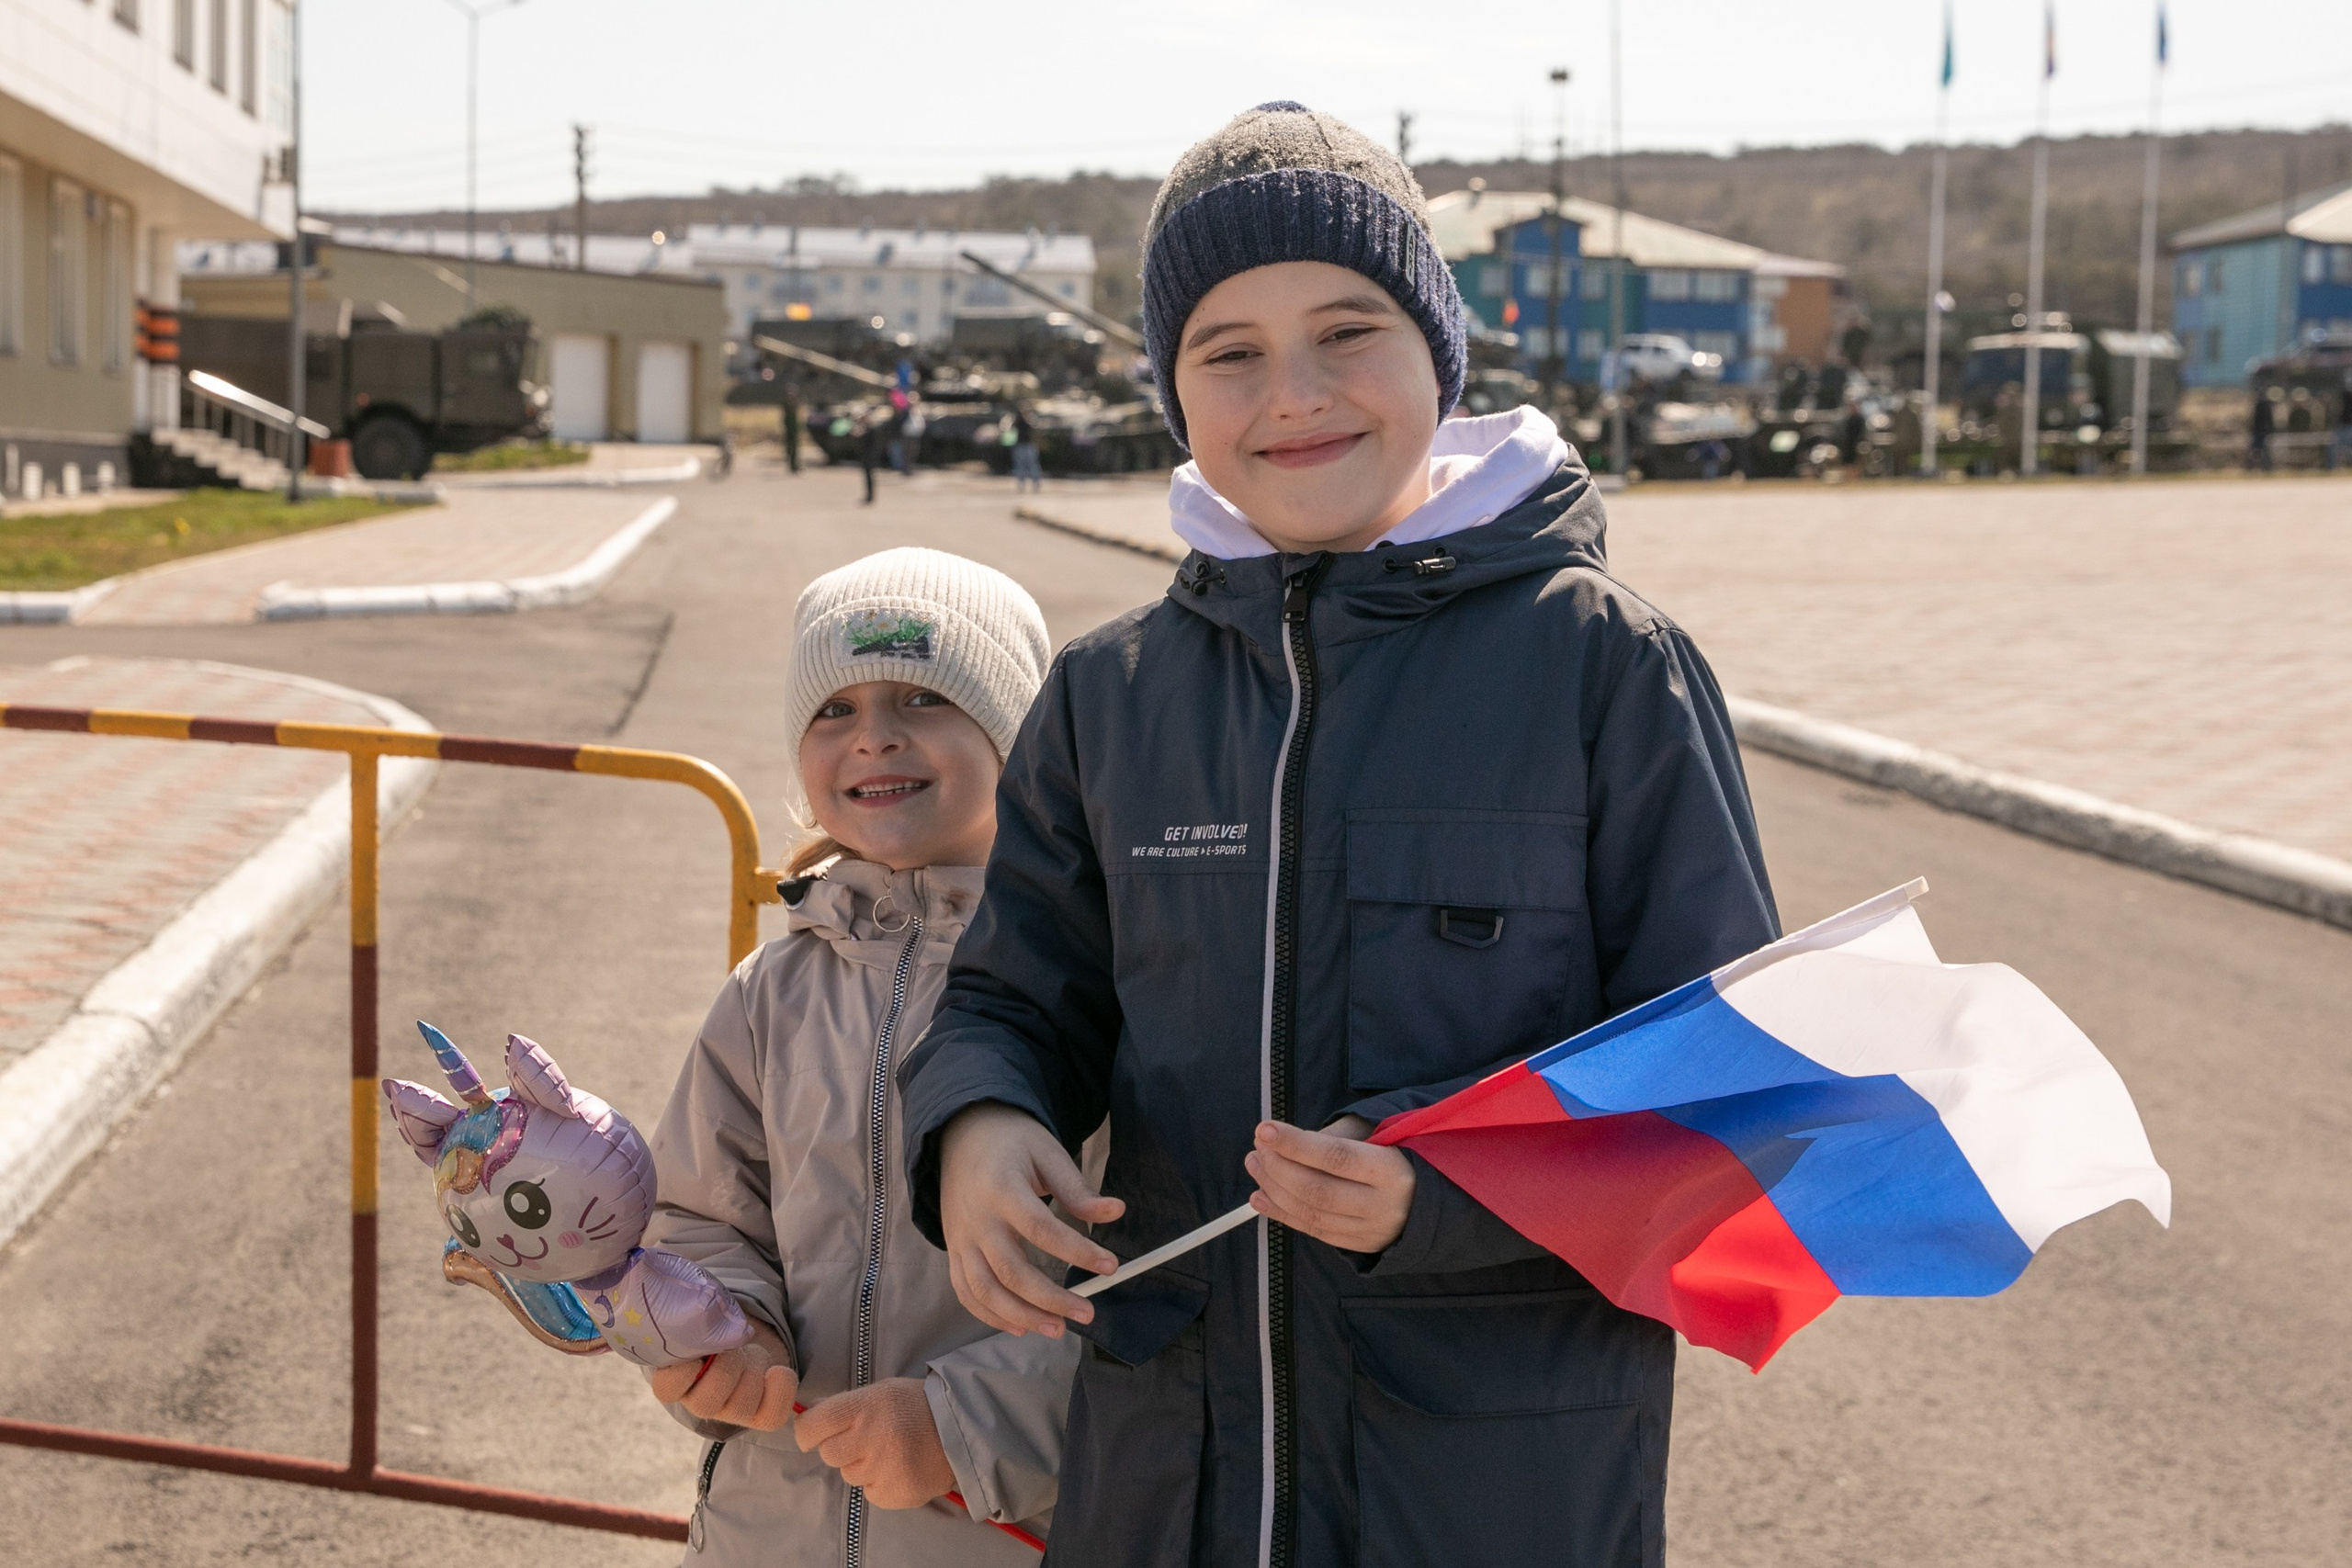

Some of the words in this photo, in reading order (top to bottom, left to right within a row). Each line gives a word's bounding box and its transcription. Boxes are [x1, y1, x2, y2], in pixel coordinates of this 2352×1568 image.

[1164, 827, 1190, 841] GET
[1191, 823, 1248, 840] INVOLVED!
[1132, 846, 1146, 856] WE
[1147, 846, 1165, 857] ARE
[1166, 847, 1199, 857] CULTURE
[1206, 844, 1247, 856] E-SPORTS
